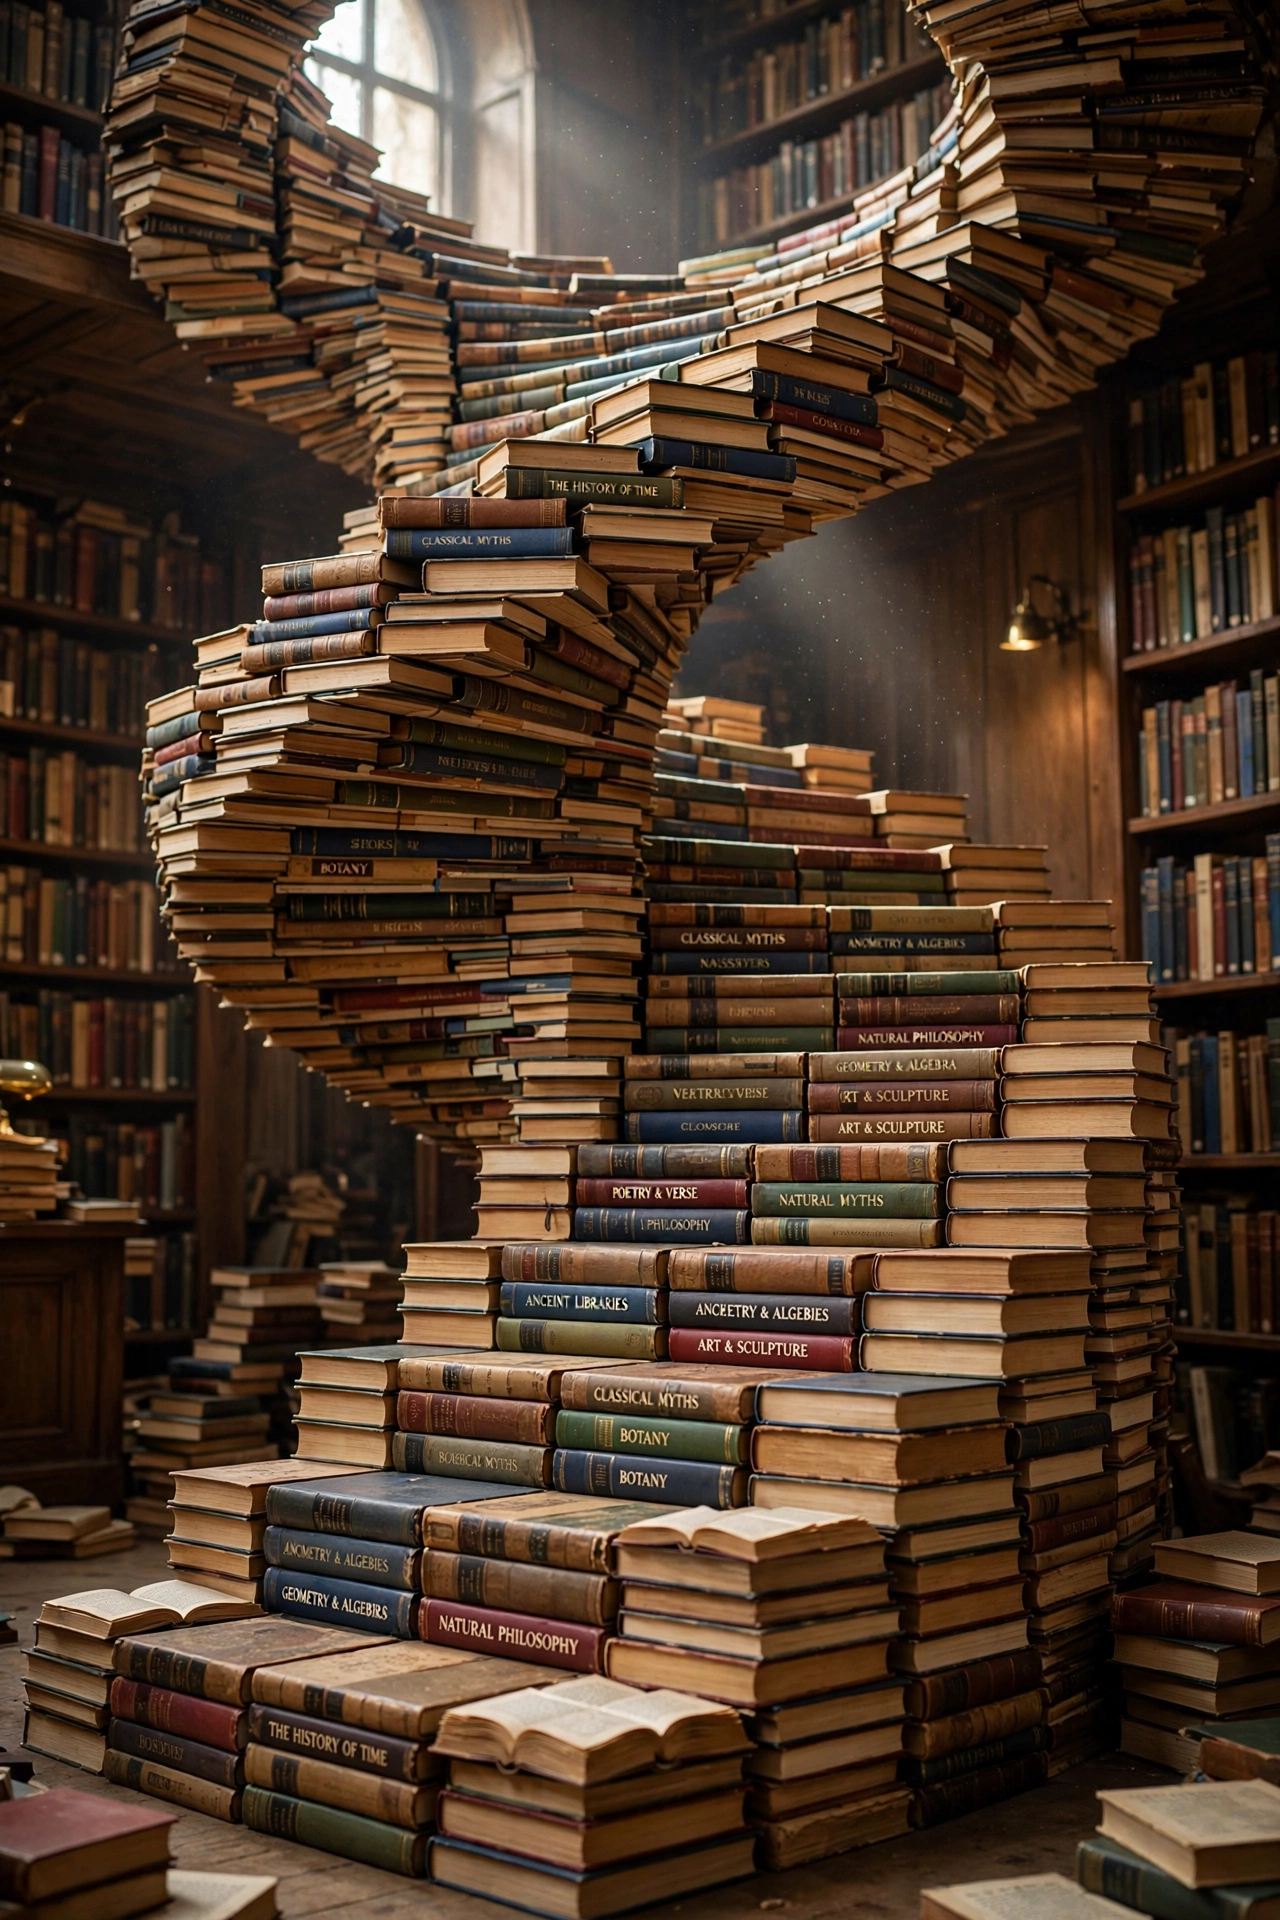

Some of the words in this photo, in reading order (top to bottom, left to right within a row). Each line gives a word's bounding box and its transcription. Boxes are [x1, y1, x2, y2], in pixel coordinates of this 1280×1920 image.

[548, 479, 570, 492] THE
[573, 481, 618, 494] HISTORY
[620, 483, 633, 496] OF
[633, 484, 659, 497] TIME
[421, 535, 474, 548] CLASSICAL
[476, 535, 512, 545] MYTHS
[320, 861, 368, 875] BOTANY
[680, 932, 742, 945] CLASSICAL
[745, 932, 786, 945] MYTHS
[905, 938, 914, 949] &
[858, 1031, 909, 1045] NATURAL
[912, 1030, 985, 1044] PHILOSOPHY
[836, 1060, 893, 1073] GEOMETRY
[895, 1061, 904, 1072] &
[906, 1058, 957, 1072] ALGEBRA
[863, 1090, 873, 1102] &
[876, 1089, 950, 1103] SCULPTURE
[838, 1121, 861, 1134] ART
[864, 1121, 873, 1134] &
[875, 1120, 946, 1134] SCULPTURE
[612, 1186, 652, 1199] POETRY
[654, 1186, 663, 1199] &
[665, 1186, 698, 1199] VERSE
[779, 1193, 834, 1207] NATURAL
[840, 1193, 884, 1207] MYTHS
[575, 1295, 629, 1311] LIBRARIES
[760, 1305, 769, 1319] &
[772, 1305, 829, 1322] ALGEBIES
[698, 1338, 722, 1352] ART
[724, 1339, 734, 1353] &
[737, 1339, 808, 1358] SCULPTURE
[593, 1386, 654, 1406] CLASSICAL
[658, 1393, 699, 1410] MYTHS
[620, 1427, 670, 1446] BOTANY
[485, 1455, 518, 1472] MYTHS
[619, 1469, 668, 1489] BOTANY
[334, 1550, 342, 1565] &
[343, 1552, 389, 1573] ALGEBIES
[281, 1585, 330, 1608] GEOMETRY
[331, 1595, 340, 1611] &
[439, 1614, 494, 1640] NATURAL
[498, 1625, 579, 1655] PHILOSOPHY
[268, 1720, 290, 1741] THE
[293, 1726, 341, 1754] HISTORY
[342, 1740, 358, 1758] OF
[360, 1743, 388, 1767] TIME
